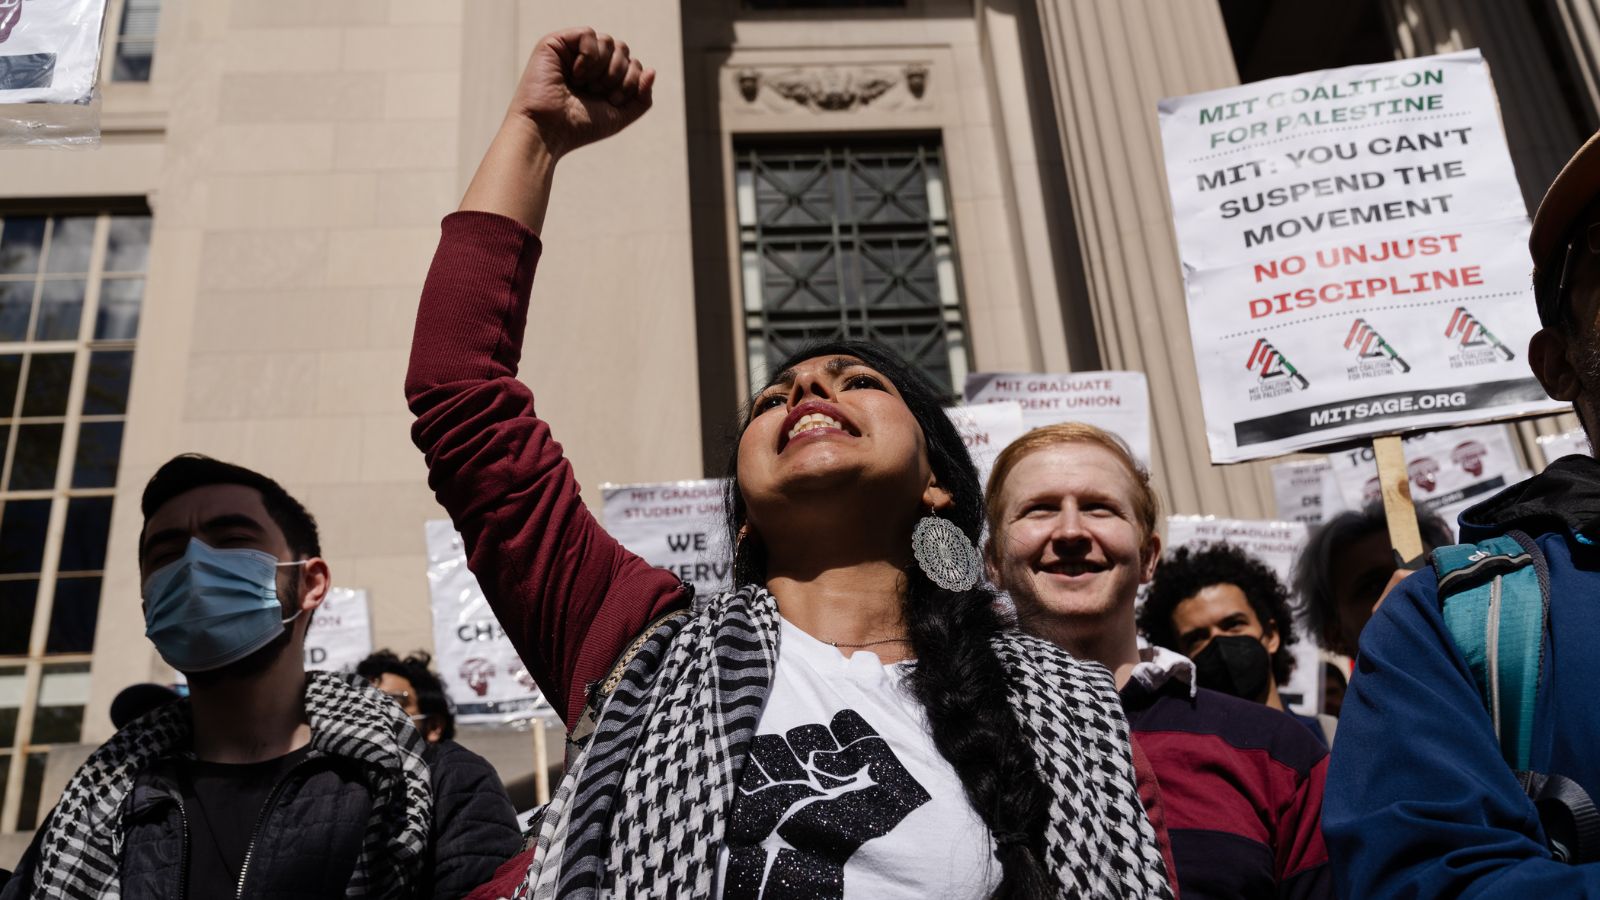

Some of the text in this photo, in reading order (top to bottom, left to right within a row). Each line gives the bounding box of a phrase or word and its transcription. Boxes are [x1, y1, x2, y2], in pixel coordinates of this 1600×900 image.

[1199, 69, 1444, 125] MIT COALITION
[1210, 95, 1444, 149] FOR PALESTINE
[1197, 127, 1472, 192] MIT: YOU CAN'T
[1220, 160, 1465, 219] SUSPEND THE
[1243, 195, 1454, 247] MOVEMENT
[1254, 234, 1463, 282] NO UNJUST
[1249, 266, 1483, 318] DISCIPLINE
[995, 379, 1112, 391] MIT GRADUATE
[1066, 397, 1121, 407] UNION
[1310, 392, 1467, 427] MITSAGE.ORG
[624, 505, 691, 518] STUDENT
[667, 533, 707, 552] WE
